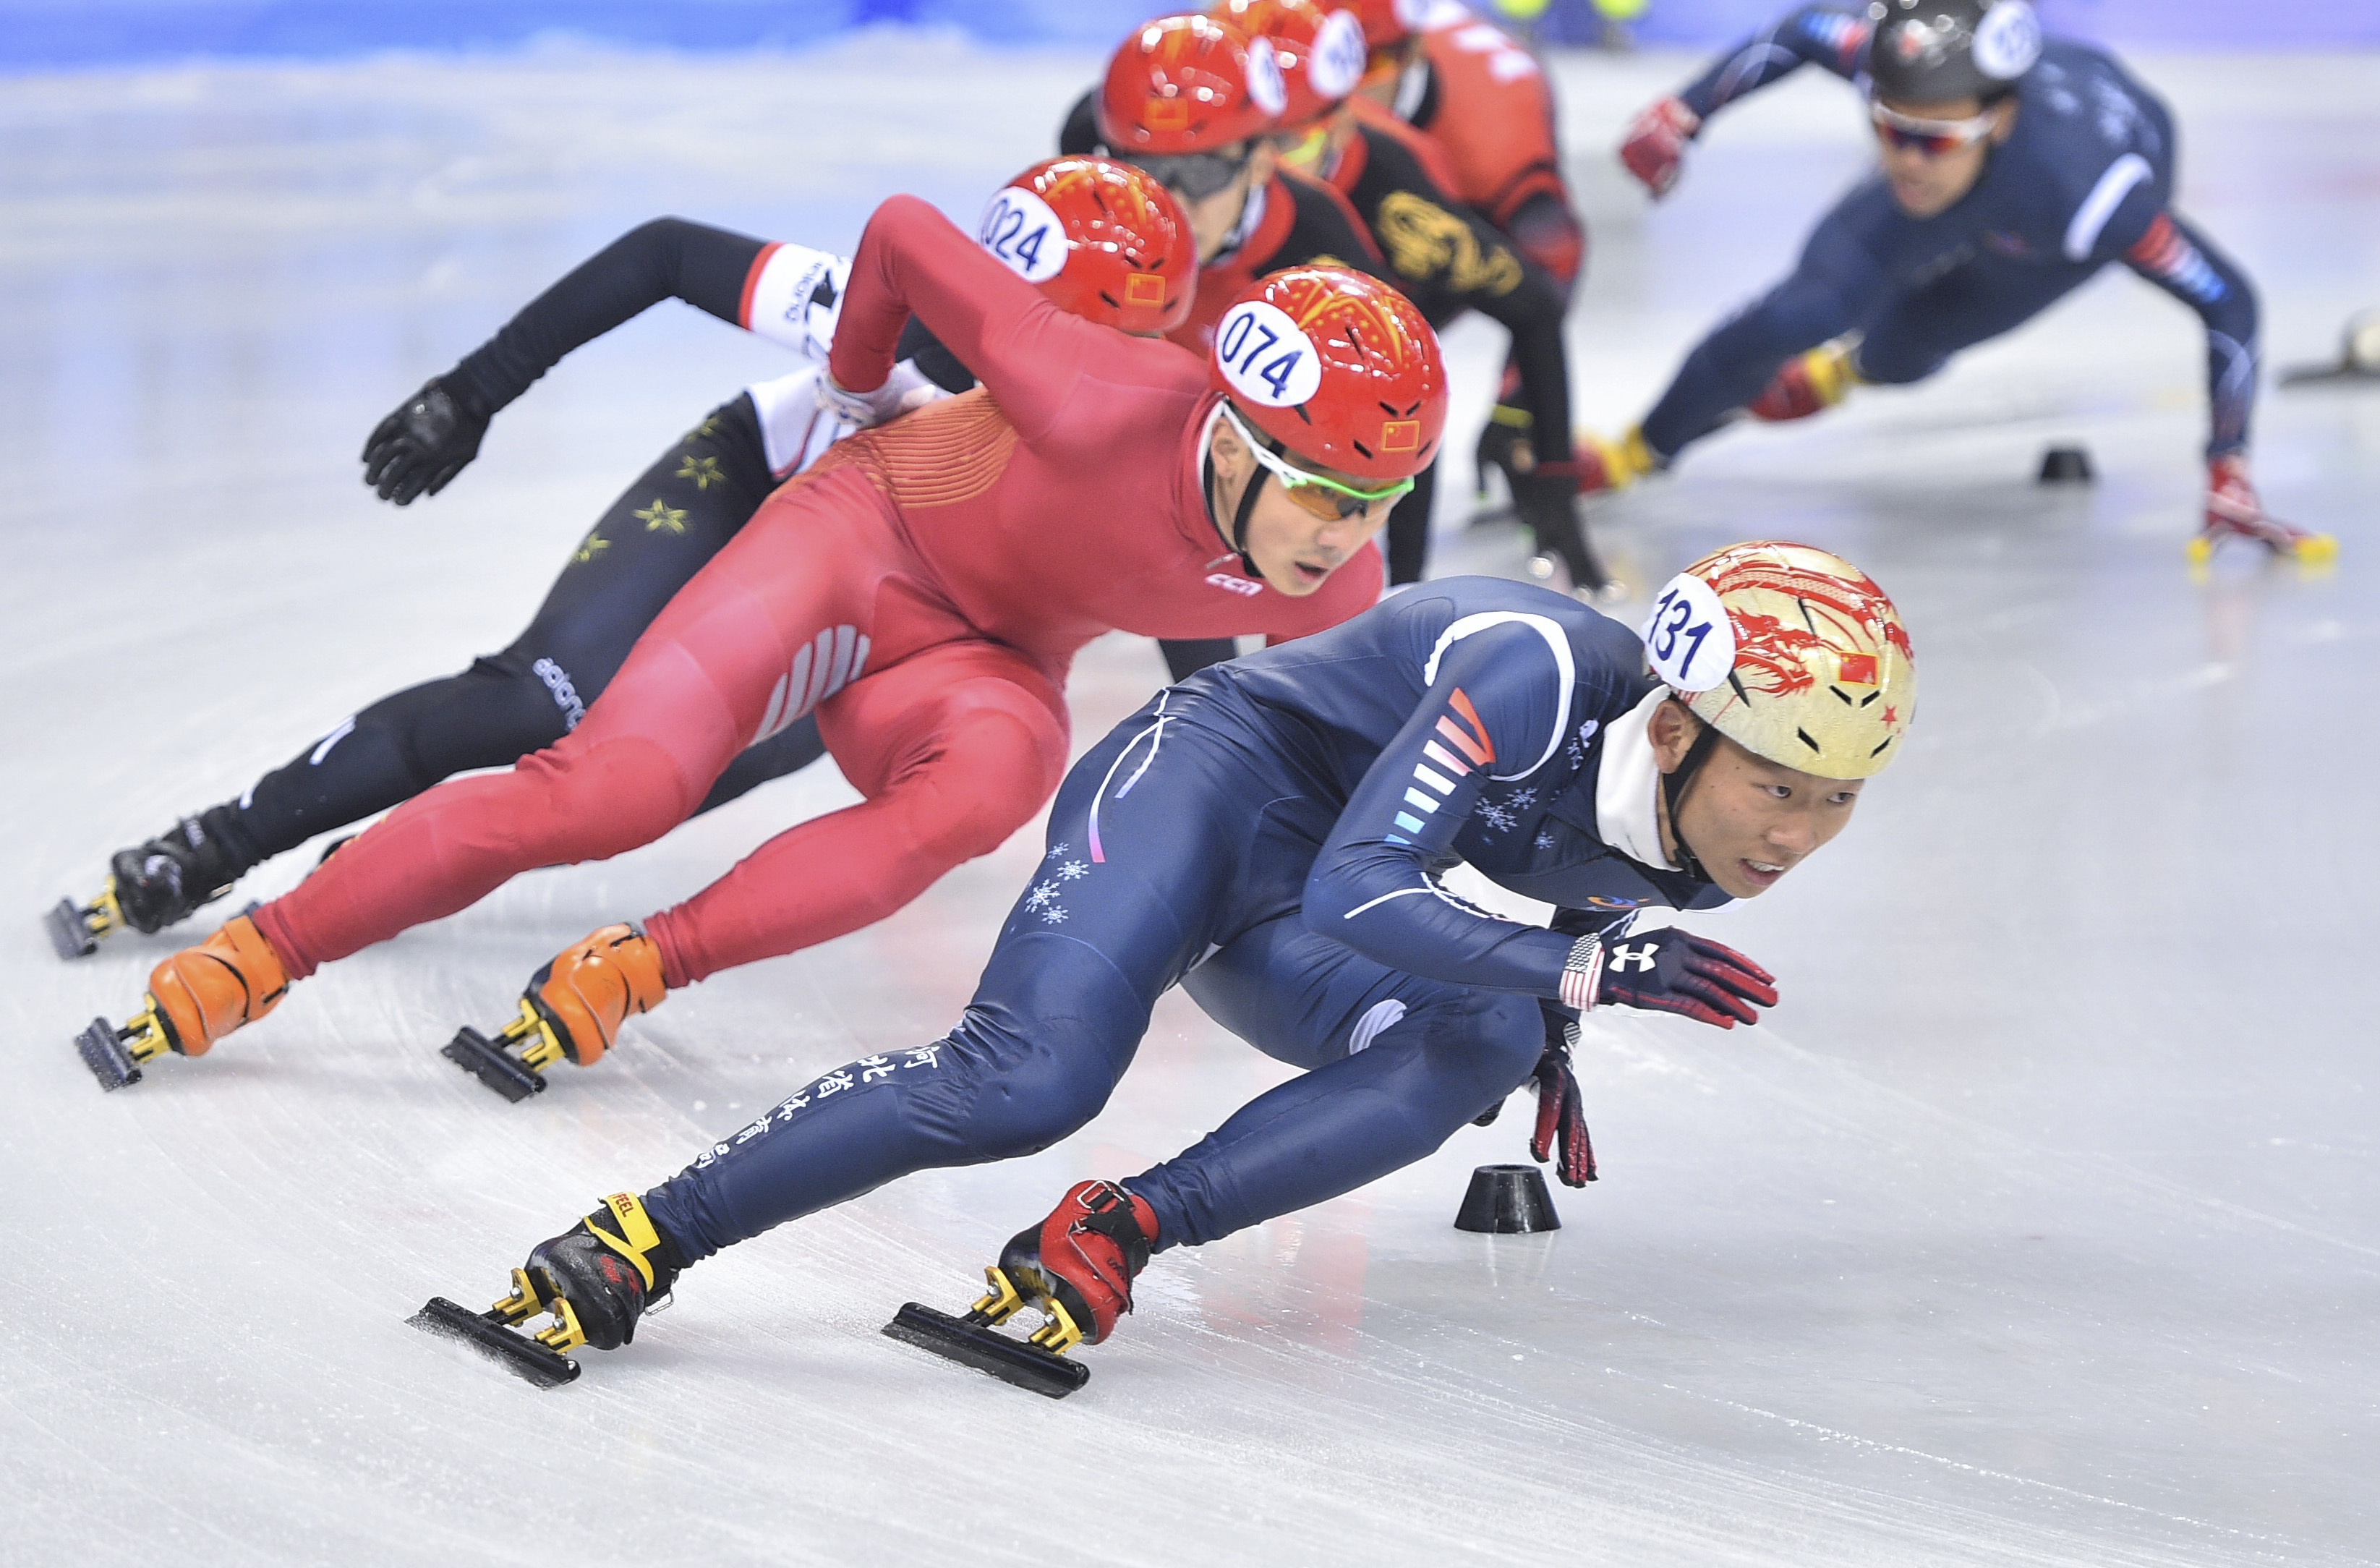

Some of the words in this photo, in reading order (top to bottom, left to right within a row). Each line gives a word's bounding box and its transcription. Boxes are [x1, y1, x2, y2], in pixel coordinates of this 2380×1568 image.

[984, 197, 1049, 271] 024
[1222, 311, 1304, 399] 074
[1648, 589, 1713, 681] 131
